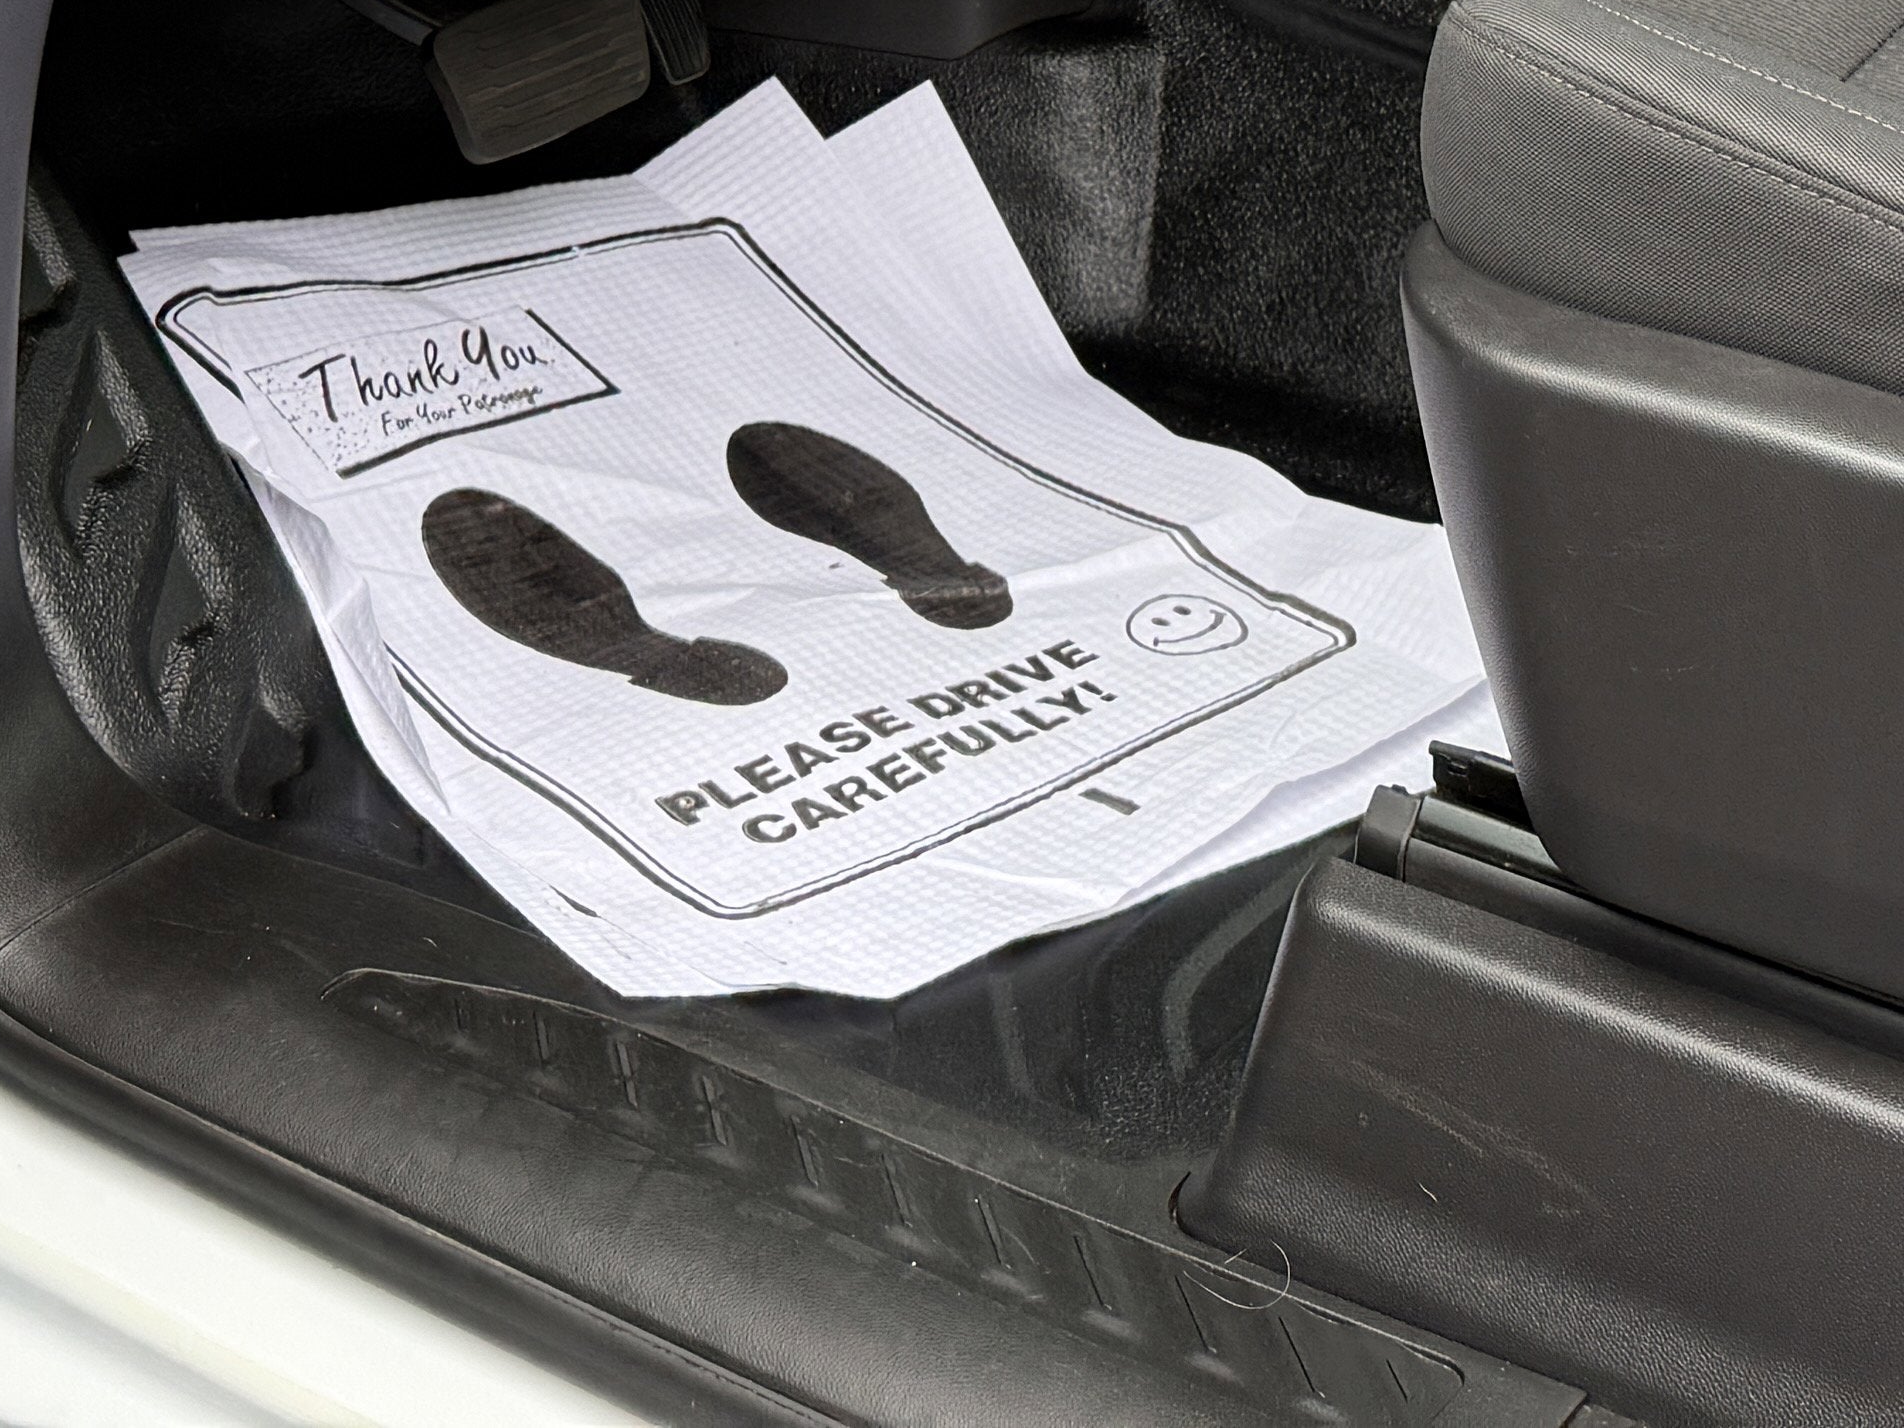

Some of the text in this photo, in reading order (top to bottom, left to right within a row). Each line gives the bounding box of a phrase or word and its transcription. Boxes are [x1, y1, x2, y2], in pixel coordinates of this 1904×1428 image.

[299, 324, 548, 423] Thank You
[381, 410, 414, 436] For
[416, 402, 456, 425] Your
[655, 639, 1100, 826] PLEASE DRIVE
[741, 680, 1118, 844] CAREFULLY!
